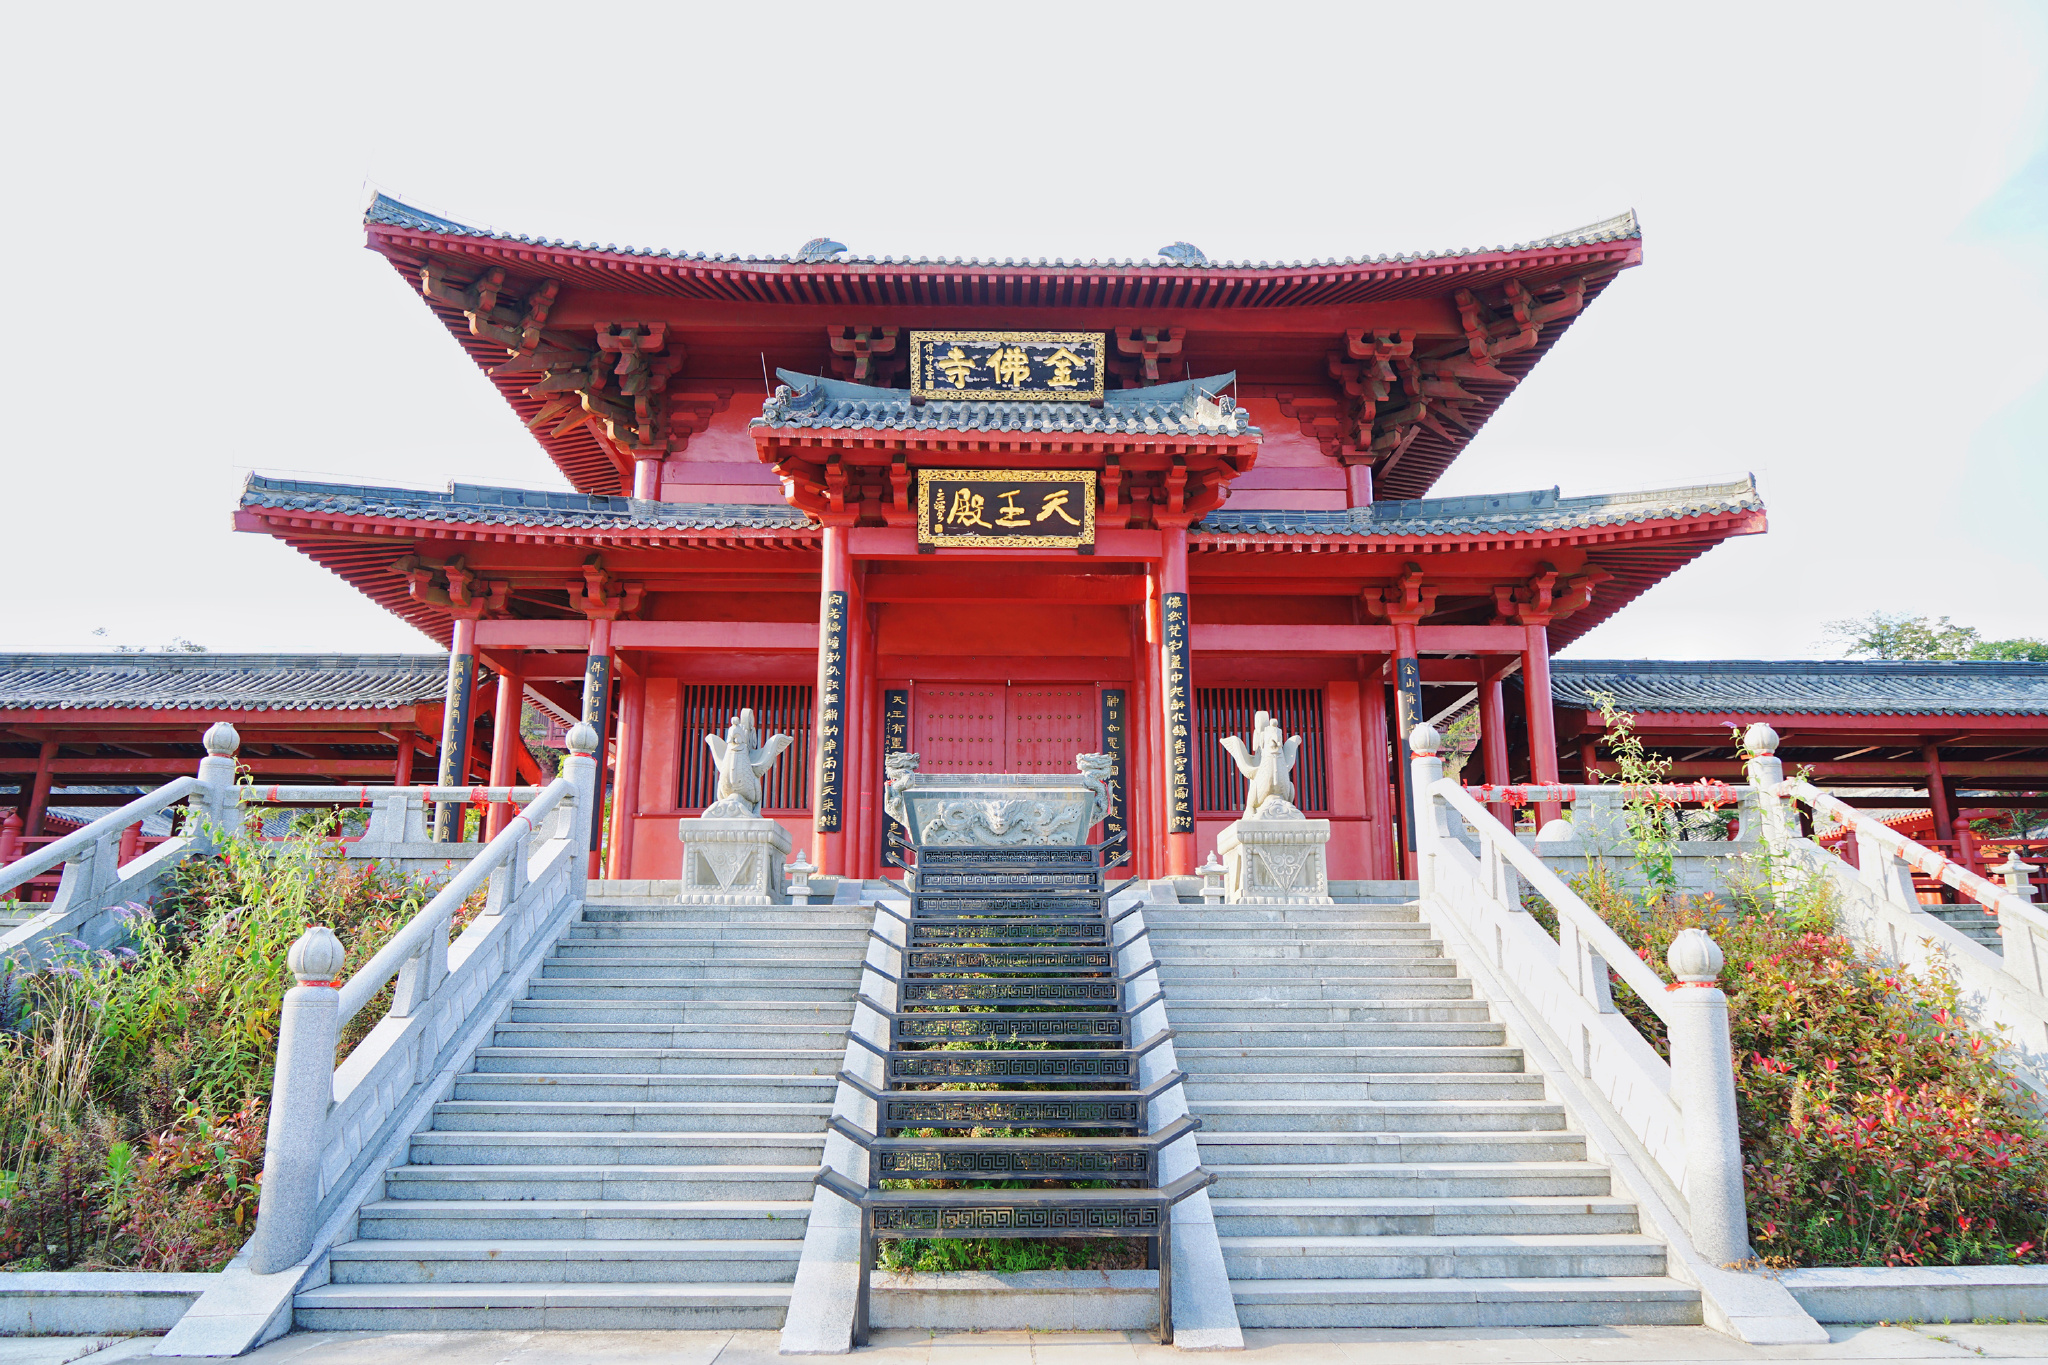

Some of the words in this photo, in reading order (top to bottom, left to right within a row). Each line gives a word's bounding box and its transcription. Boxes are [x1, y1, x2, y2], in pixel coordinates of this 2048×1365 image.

[938, 346, 1086, 389] 金佛寺
[946, 487, 1081, 529] 天王殿
